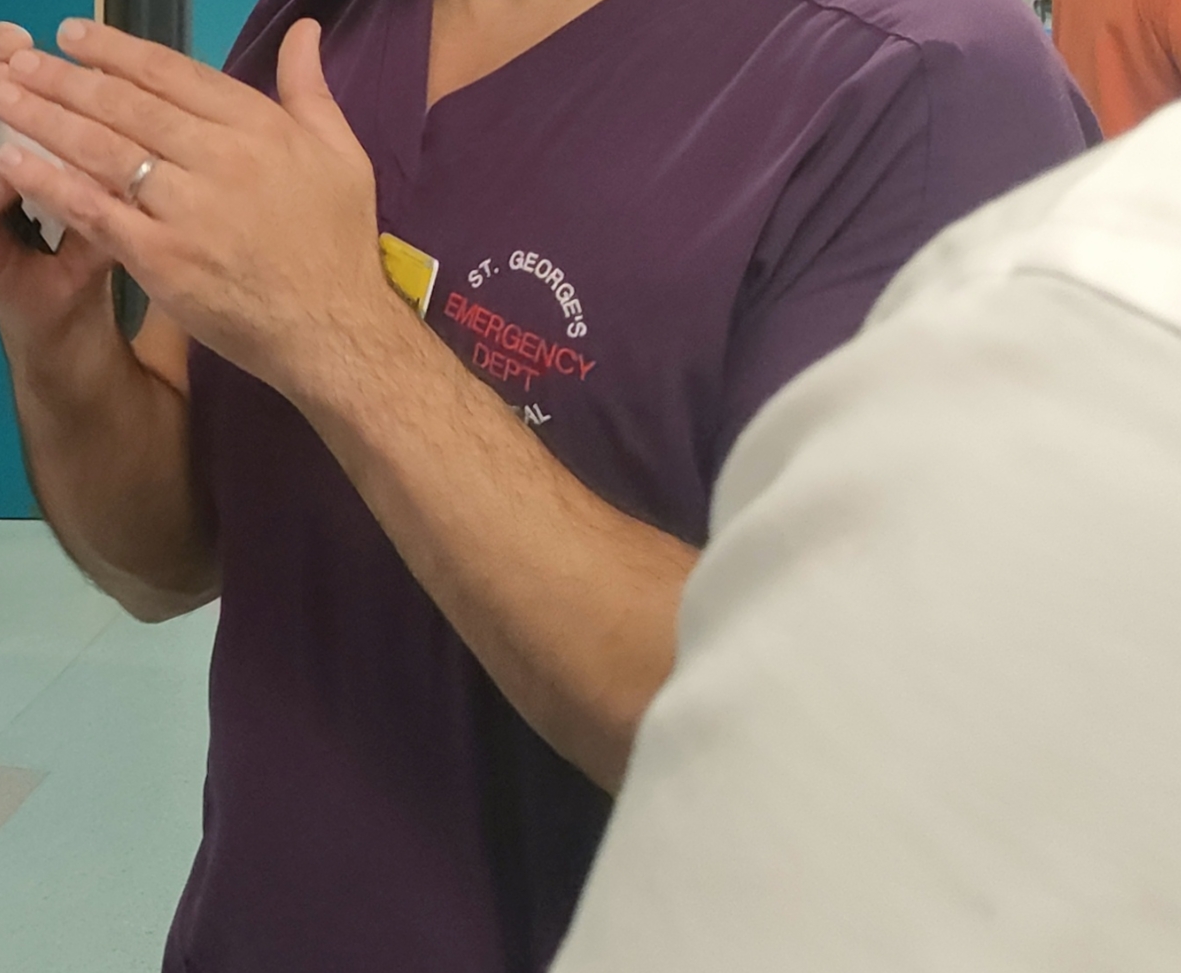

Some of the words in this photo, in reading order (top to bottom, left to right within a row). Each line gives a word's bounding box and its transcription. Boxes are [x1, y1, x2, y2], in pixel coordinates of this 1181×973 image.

[443, 291, 596, 382] EMERGENCY
[467, 258, 500, 288] ST.
[509, 250, 588, 339] GEORGE'S
[472, 342, 540, 392] DEPT
